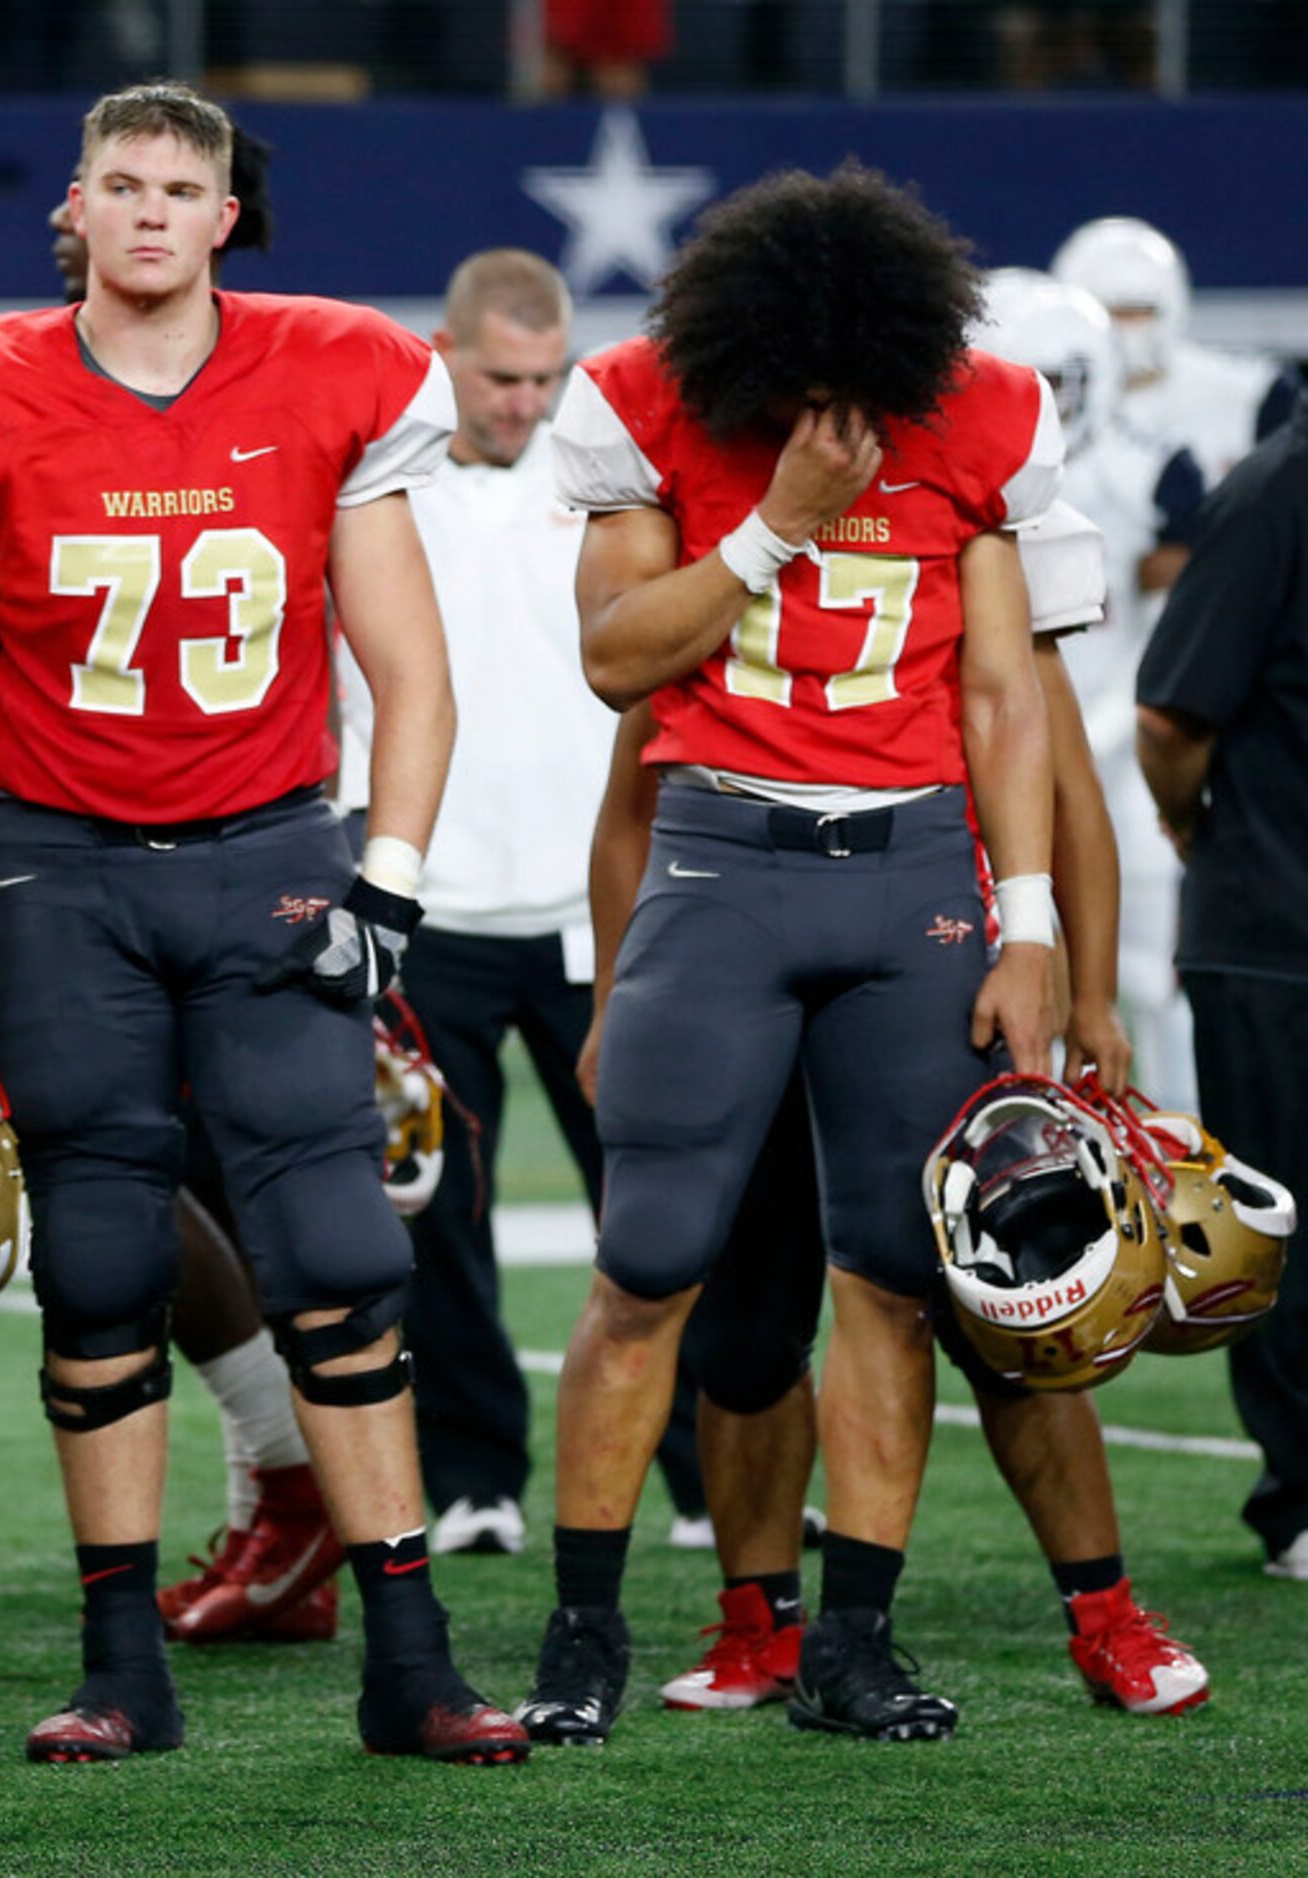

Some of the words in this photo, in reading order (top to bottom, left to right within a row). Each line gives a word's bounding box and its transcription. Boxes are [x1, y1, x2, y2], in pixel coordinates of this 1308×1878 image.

[101, 487, 235, 517] WARRIORS
[813, 516, 891, 543] RIORS
[49, 527, 287, 716] 73
[725, 551, 920, 711] 17
[980, 1279, 1087, 1321] Riddell
